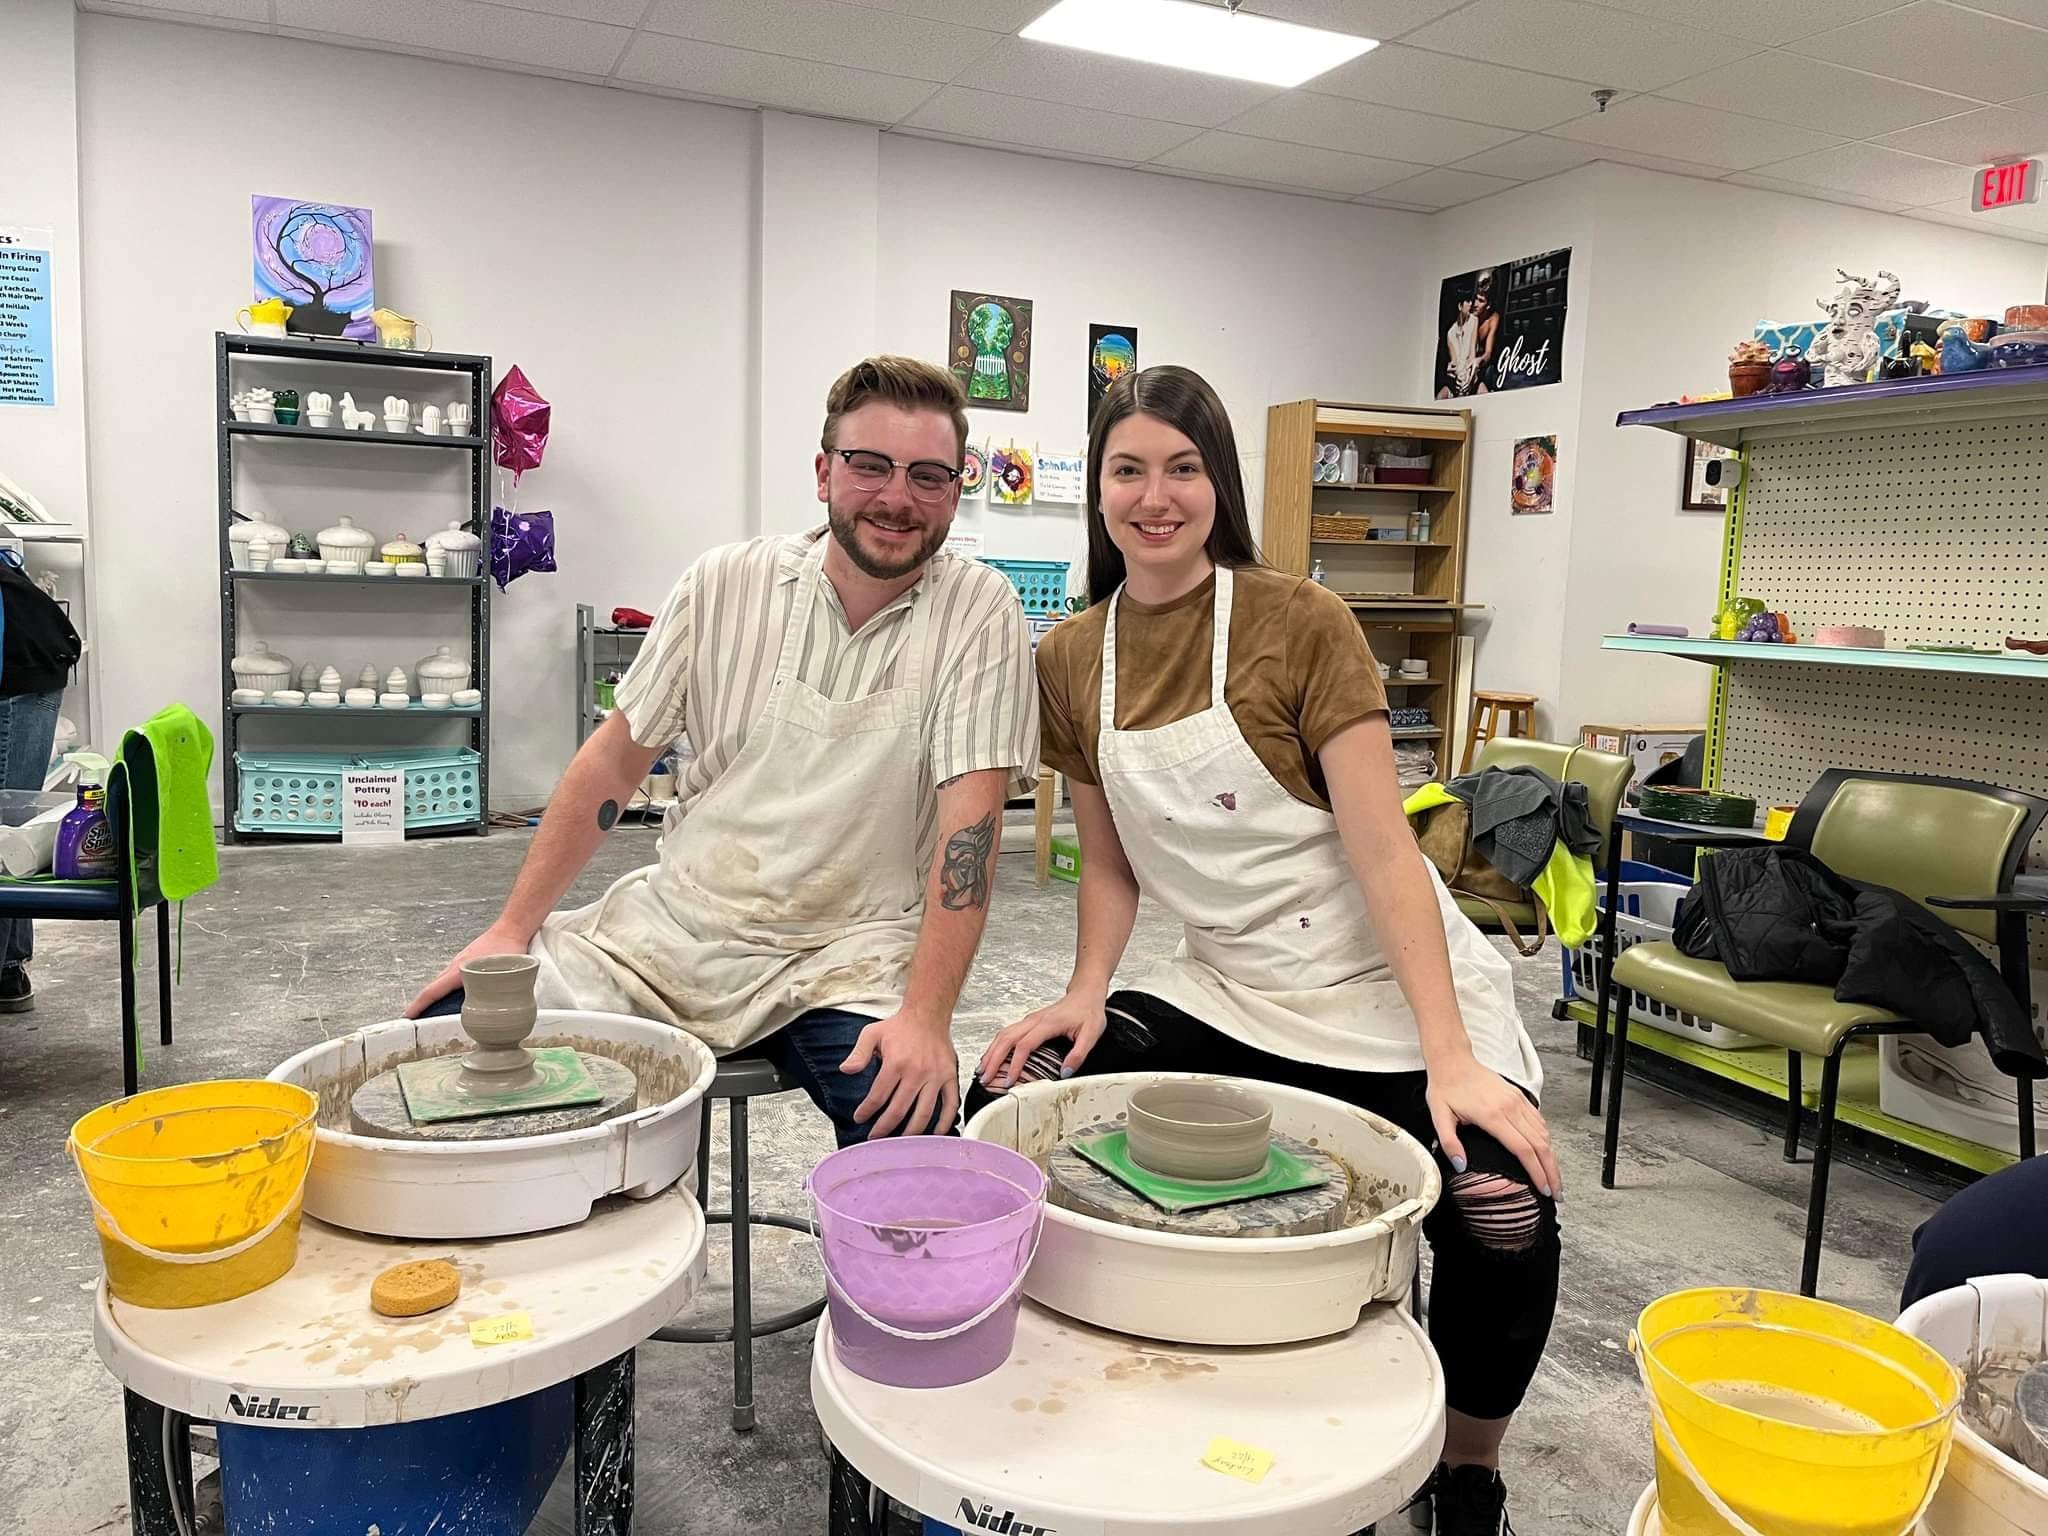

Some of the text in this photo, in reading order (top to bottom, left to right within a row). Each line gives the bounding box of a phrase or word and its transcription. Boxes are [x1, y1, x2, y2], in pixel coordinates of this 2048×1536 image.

[1983, 162, 2028, 206] EXIT
[11, 252, 42, 263] Firing
[24, 294, 44, 302] Dryer
[4, 331, 27, 339] Charge
[5, 363, 33, 371] Planters
[348, 775, 397, 784] Unclaimed
[354, 786, 391, 795] Pottery
[370, 799, 392, 808] each!
[225, 1393, 321, 1422] Nidec
